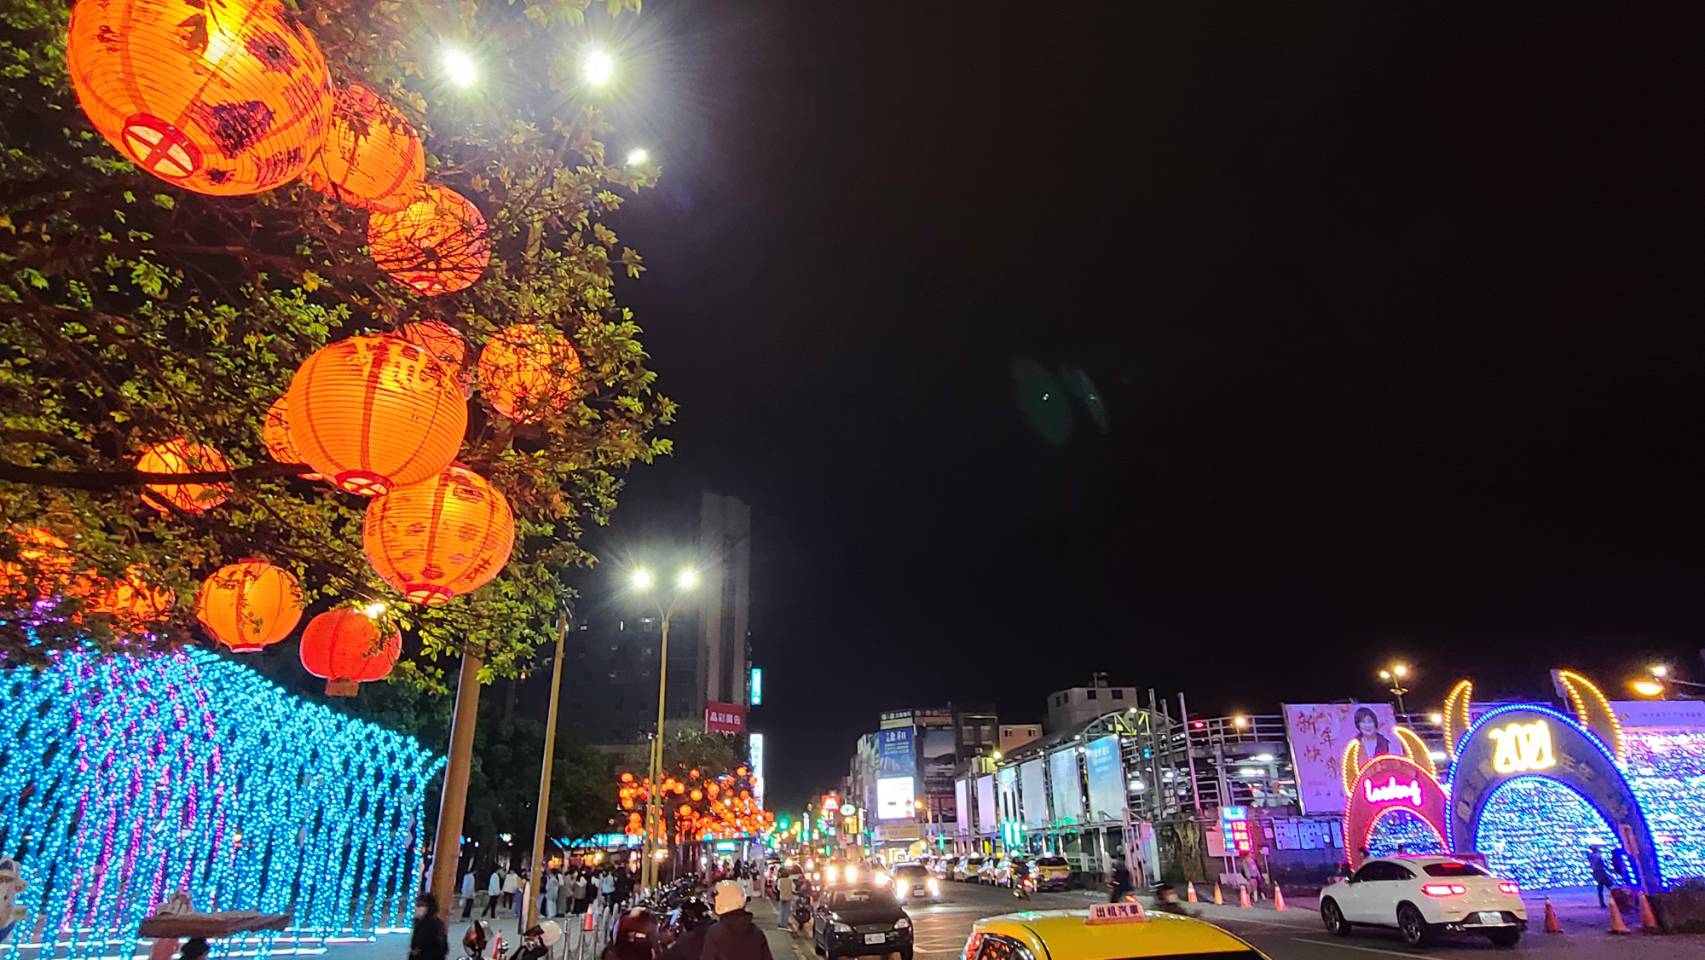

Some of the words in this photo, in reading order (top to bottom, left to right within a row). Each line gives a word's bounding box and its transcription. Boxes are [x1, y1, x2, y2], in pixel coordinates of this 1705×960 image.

[709, 711, 742, 725] 晶彩廣告
[1488, 719, 1556, 773] 2021
